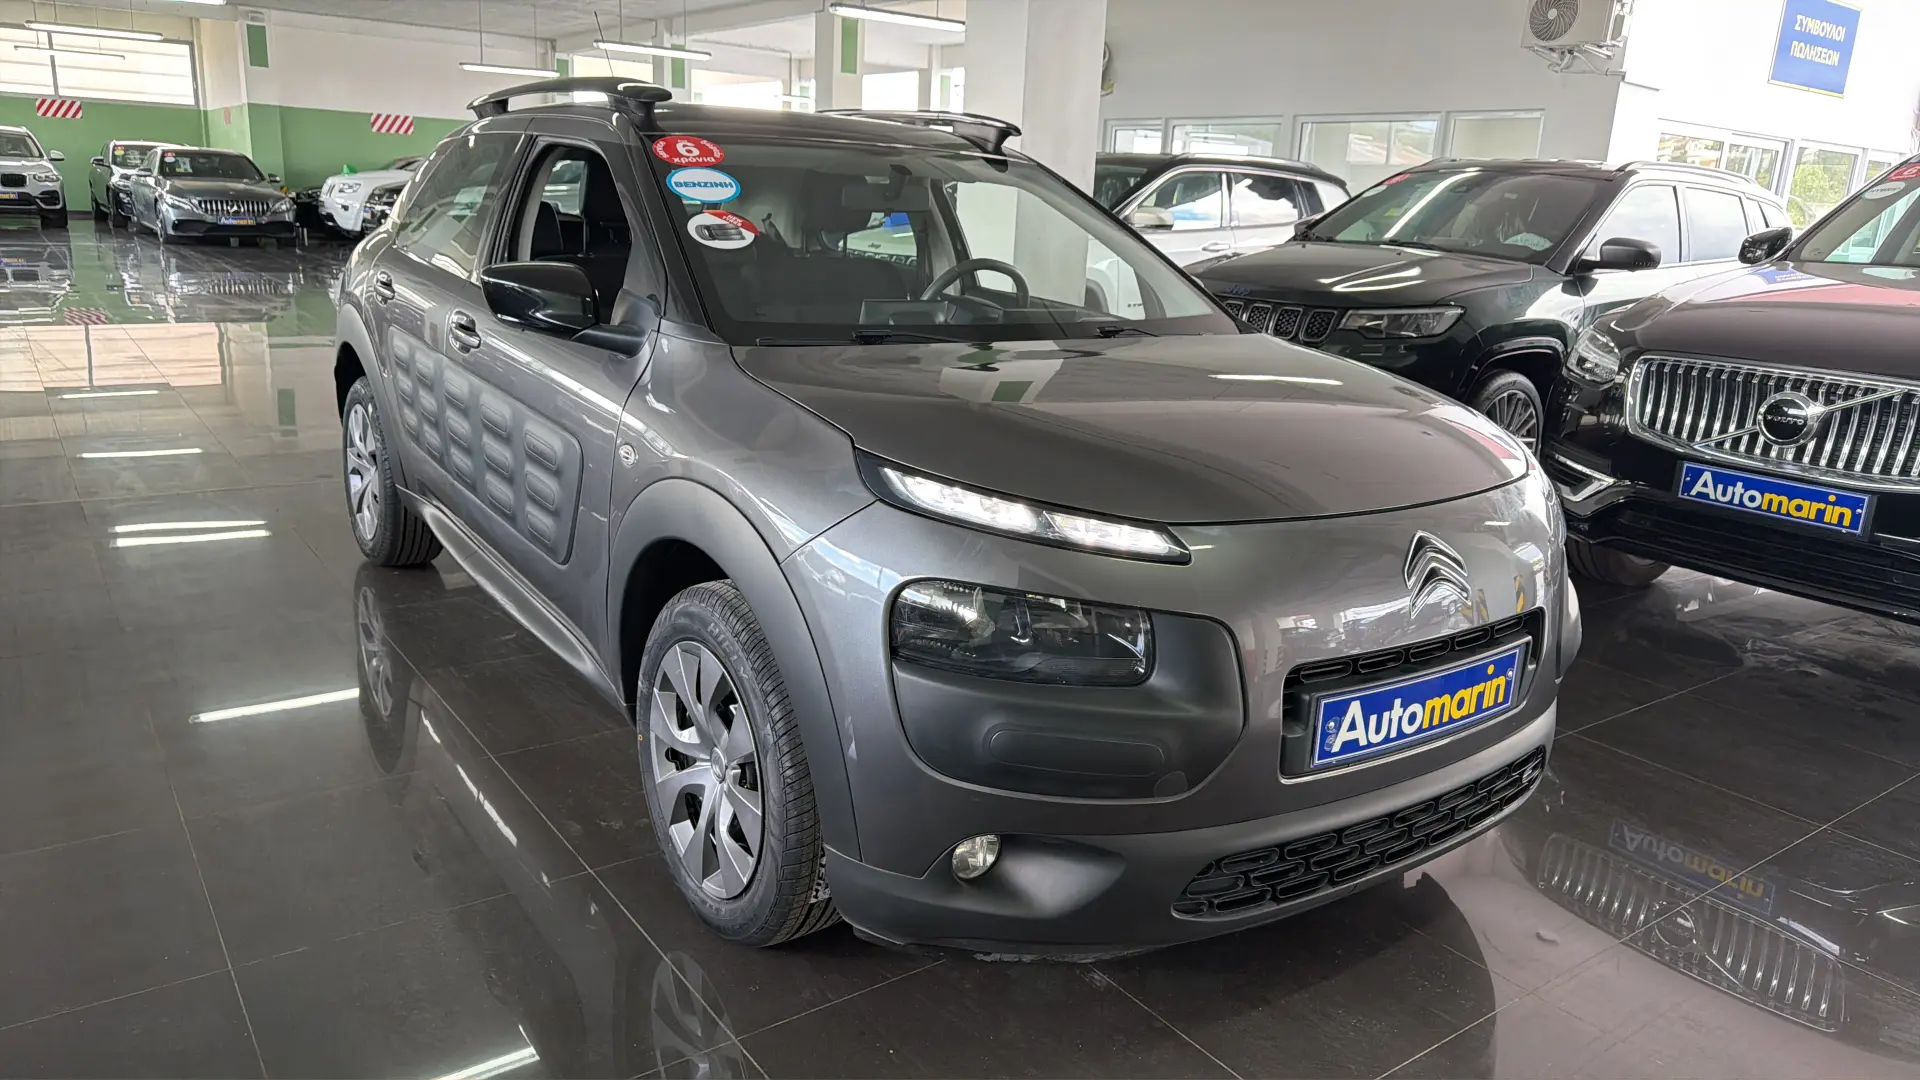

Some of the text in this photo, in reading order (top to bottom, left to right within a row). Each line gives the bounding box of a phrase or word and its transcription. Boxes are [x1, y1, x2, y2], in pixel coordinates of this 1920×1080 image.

[1794, 14, 1846, 42] ΣΥΜΒΟΥΛΟΙ
[1790, 40, 1840, 66] ΠΩΛΗΣΕΩΝ
[673, 156, 716, 164] χρόνια
[675, 142, 700, 157] 6
[1689, 470, 1852, 527] Automarin
[1331, 664, 1507, 753] Automarin
